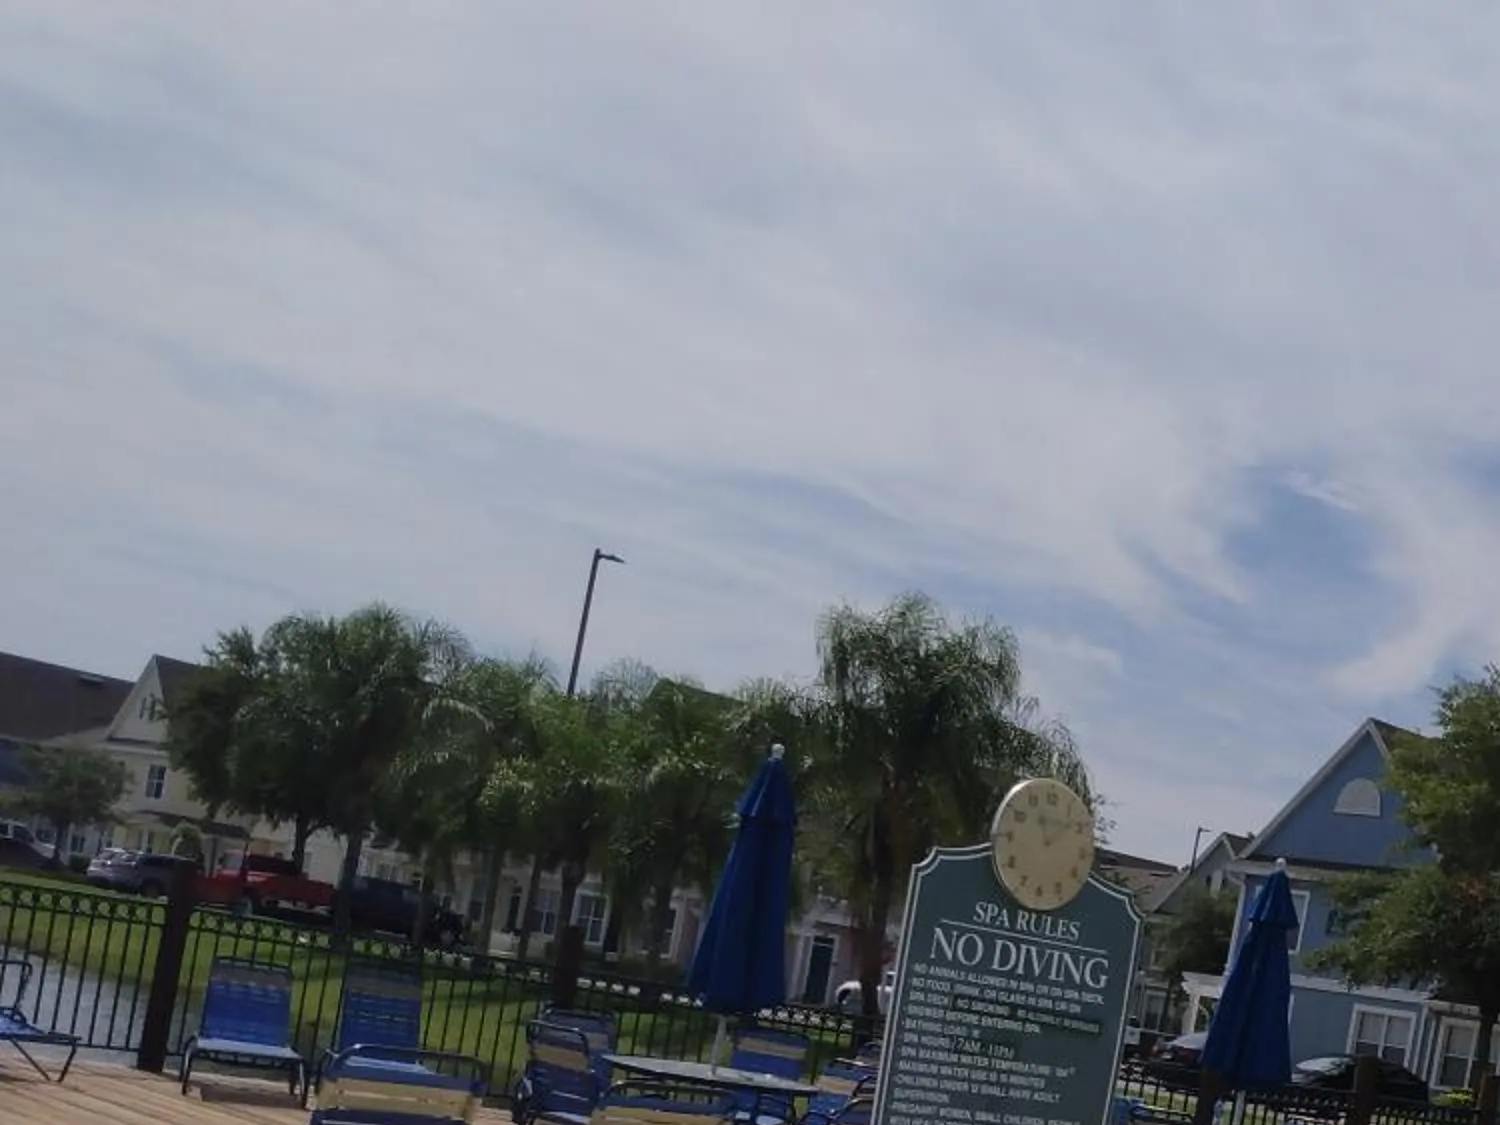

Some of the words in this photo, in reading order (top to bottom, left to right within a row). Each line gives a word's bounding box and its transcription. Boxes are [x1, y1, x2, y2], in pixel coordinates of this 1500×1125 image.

[973, 901, 1012, 927] SPA
[1016, 910, 1080, 940] RULES
[930, 927, 984, 966] NO
[992, 938, 1109, 988] DIVING
